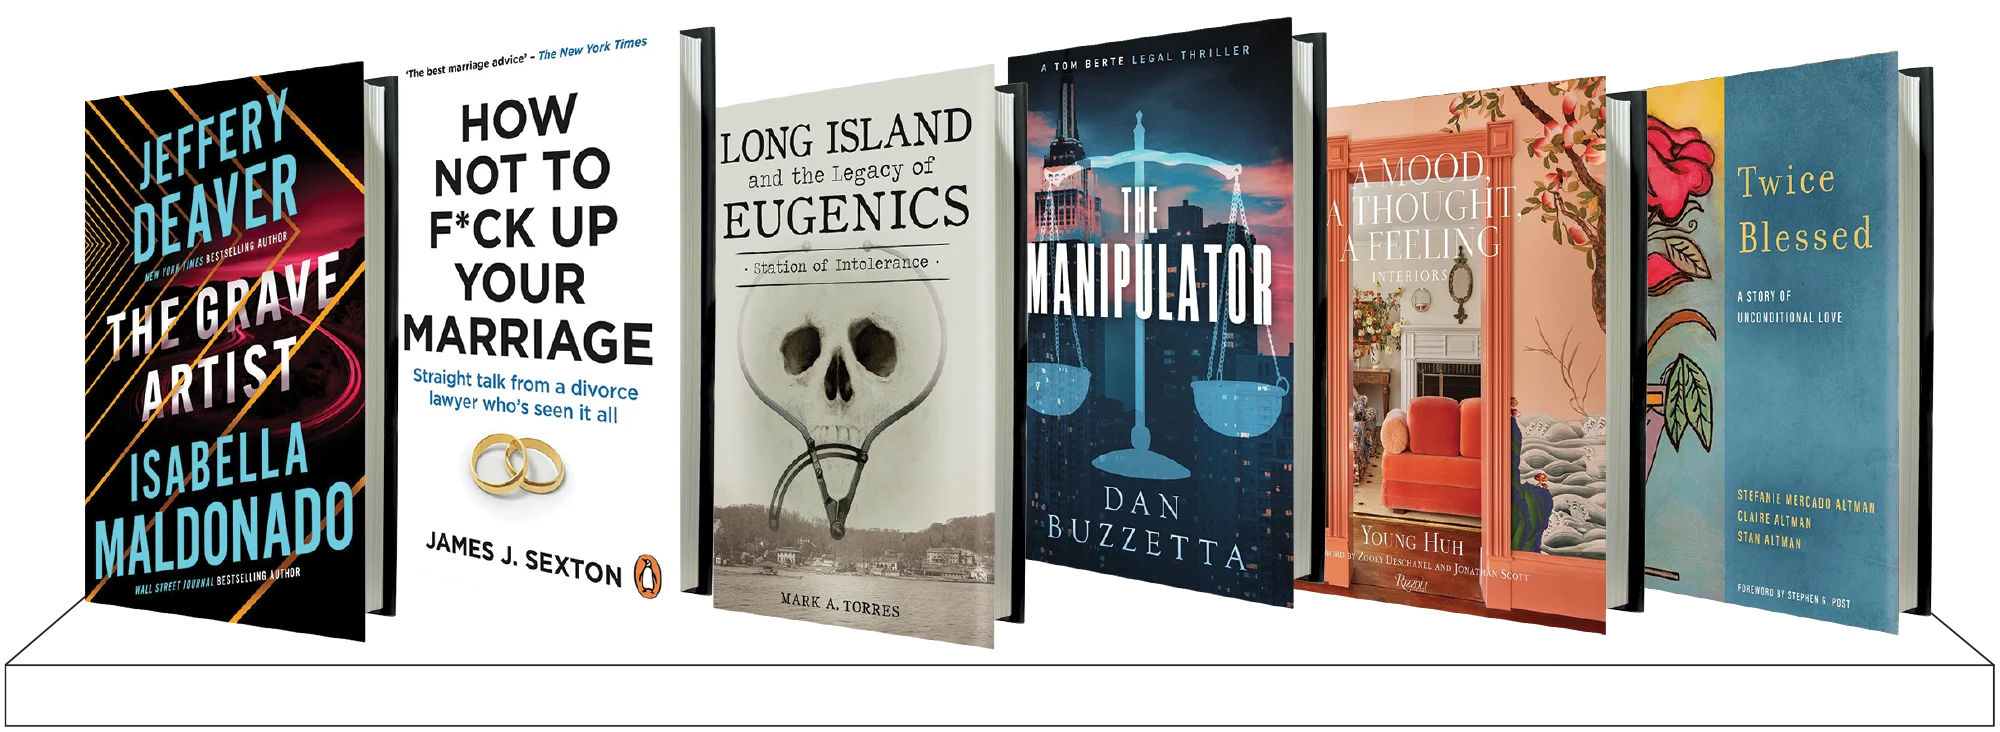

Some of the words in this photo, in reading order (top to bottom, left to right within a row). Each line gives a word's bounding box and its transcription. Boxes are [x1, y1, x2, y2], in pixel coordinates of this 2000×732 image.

[426, 65, 446, 77] best
[448, 60, 490, 76] marriage
[538, 50, 557, 61] The
[559, 46, 583, 59] New
[586, 41, 611, 55] York
[614, 36, 648, 51] Times
[1040, 62, 1047, 73] A
[1054, 60, 1078, 72] TOM
[1085, 55, 1124, 70] BERTE
[1132, 51, 1173, 66] LEGAL
[1181, 44, 1250, 61] THRILLER
[462, 92, 578, 142] HOW
[720, 123, 814, 165] LONG
[825, 107, 973, 155] ISLAND
[139, 87, 289, 191] JEFFERY
[435, 151, 527, 197] NOT
[543, 147, 611, 191] TO
[748, 169, 784, 189] and
[791, 167, 826, 184] the
[831, 161, 905, 186] Legacy
[911, 155, 937, 176] of
[1351, 160, 1371, 190] A
[1380, 150, 1490, 188] MOOD,
[1737, 164, 1835, 198] Twice
[133, 153, 298, 265] DEAVER
[552, 204, 618, 248] UP
[722, 184, 972, 240] EUGENICS
[1121, 186, 1158, 234] THE
[1327, 198, 1344, 227] A
[1352, 186, 1523, 225] THOUGHT,
[1339, 233, 1360, 263] A
[1368, 225, 1500, 261] FEELING
[1738, 215, 1874, 254] Blessed
[144, 267, 161, 283] NEW
[162, 261, 180, 277] YORK
[181, 255, 204, 272] TIMES
[205, 242, 254, 263] BESTSELLING
[257, 230, 288, 249] AUTHOR
[753, 258, 808, 275] Station
[812, 258, 829, 272] of
[835, 255, 930, 272] Intolerance
[1371, 269, 1449, 283] INTERIORS
[454, 262, 586, 305] YOUR
[1027, 242, 1274, 327] MANIPULATOR
[1737, 291, 1743, 303] A
[1746, 290, 1776, 303] STORY
[1779, 289, 1792, 302] OF
[105, 296, 181, 362] THE
[195, 250, 340, 341] GRAVE
[1737, 311, 1815, 324] UNCONDITIONAL
[1818, 311, 1843, 324] LOVE
[403, 313, 654, 366] MARRIAGE
[140, 335, 297, 424] ARTIST
[412, 367, 473, 390] Straight
[476, 372, 506, 390] talk
[510, 374, 550, 394] from
[555, 380, 566, 395] a
[570, 379, 640, 401] divorce
[428, 390, 479, 411] lawyer
[533, 402, 574, 419] seen
[579, 404, 592, 421] it
[596, 406, 619, 424] all
[130, 421, 309, 502] ISABELLA
[1104, 485, 1180, 521] DAN
[1737, 489, 1782, 505] STEFANIE
[1785, 495, 1831, 510] MERCADO
[1835, 499, 1876, 514] ALTMAN
[1737, 510, 1771, 525] CLAIRE
[1774, 515, 1812, 529] ALTMAN
[95, 481, 354, 580] MALDONADO
[1047, 513, 1247, 571] BUZZETTA
[1737, 531, 1761, 545] STAN
[1764, 535, 1802, 550] ALTMAN
[425, 530, 495, 562] JAMES
[500, 545, 518, 567] J.
[525, 549, 623, 588] SEXTON
[1347, 552, 1356, 561] BY
[134, 584, 153, 596] WALL
[154, 579, 181, 594] STREET
[182, 576, 215, 591] JOURNAL
[216, 571, 268, 587] BESTSELLING
[270, 566, 302, 581] AUTHOR
[1737, 583, 1774, 598] FOREWORD
[1776, 589, 1785, 600] BY
[1787, 590, 1820, 605] STEPHEN
[1831, 597, 1851, 609] POST
[780, 592, 821, 608] MARK
[825, 597, 840, 611] A.
[843, 600, 901, 618] TORRES
